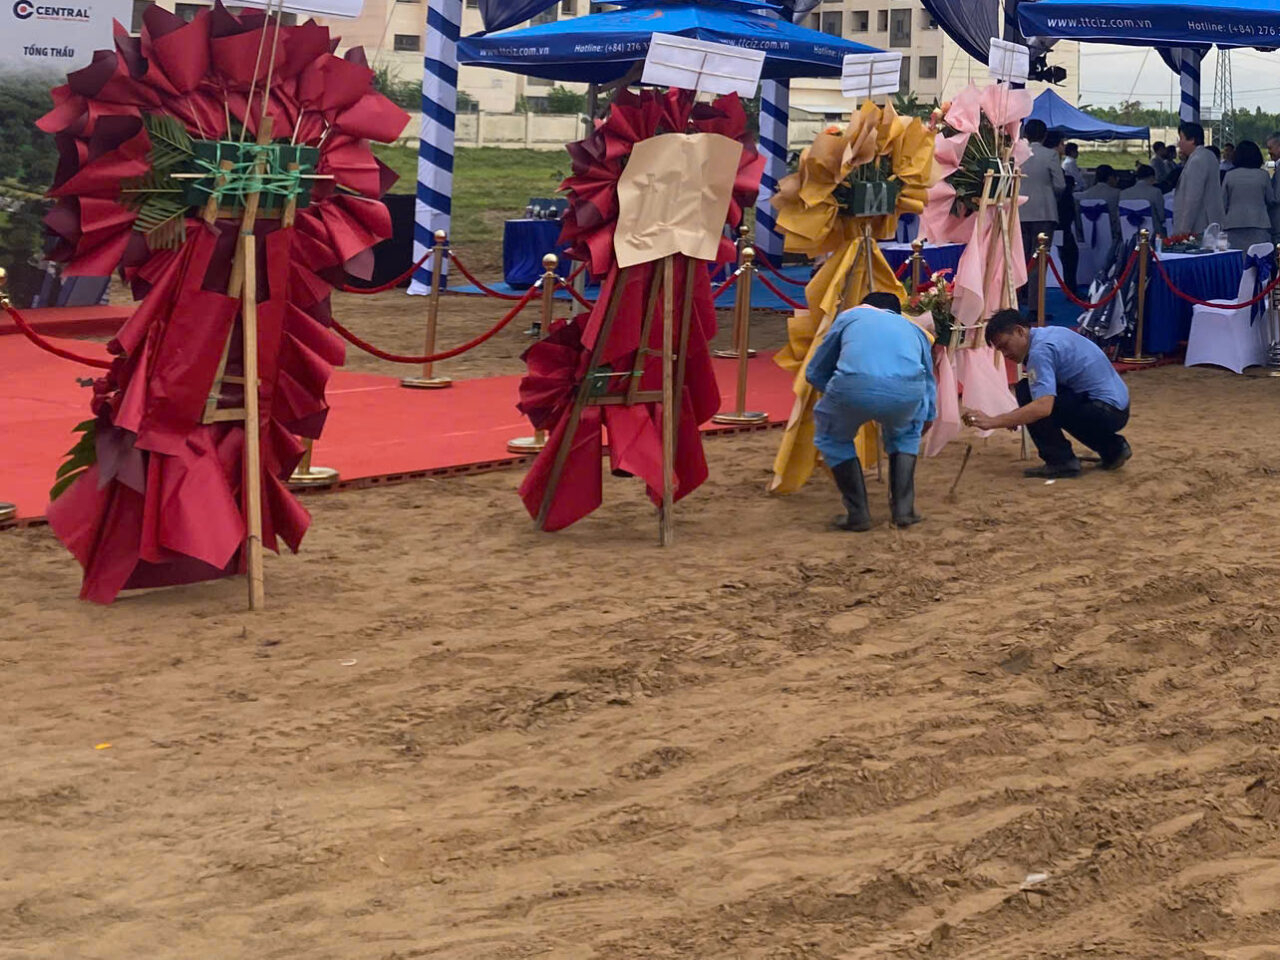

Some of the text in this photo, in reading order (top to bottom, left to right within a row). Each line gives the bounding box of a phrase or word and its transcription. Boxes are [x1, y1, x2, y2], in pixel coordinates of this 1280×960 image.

[36, 6, 90, 18] CENTRAL
[1047, 18, 1152, 29] www.ttciz.com.vn
[1187, 20, 1227, 32] Hotline:
[1228, 23, 1255, 36] (+84)
[1257, 26, 1276, 36] 276
[574, 43, 603, 53] Hotline:
[605, 41, 625, 54] (+84)
[627, 42, 642, 51] 276
